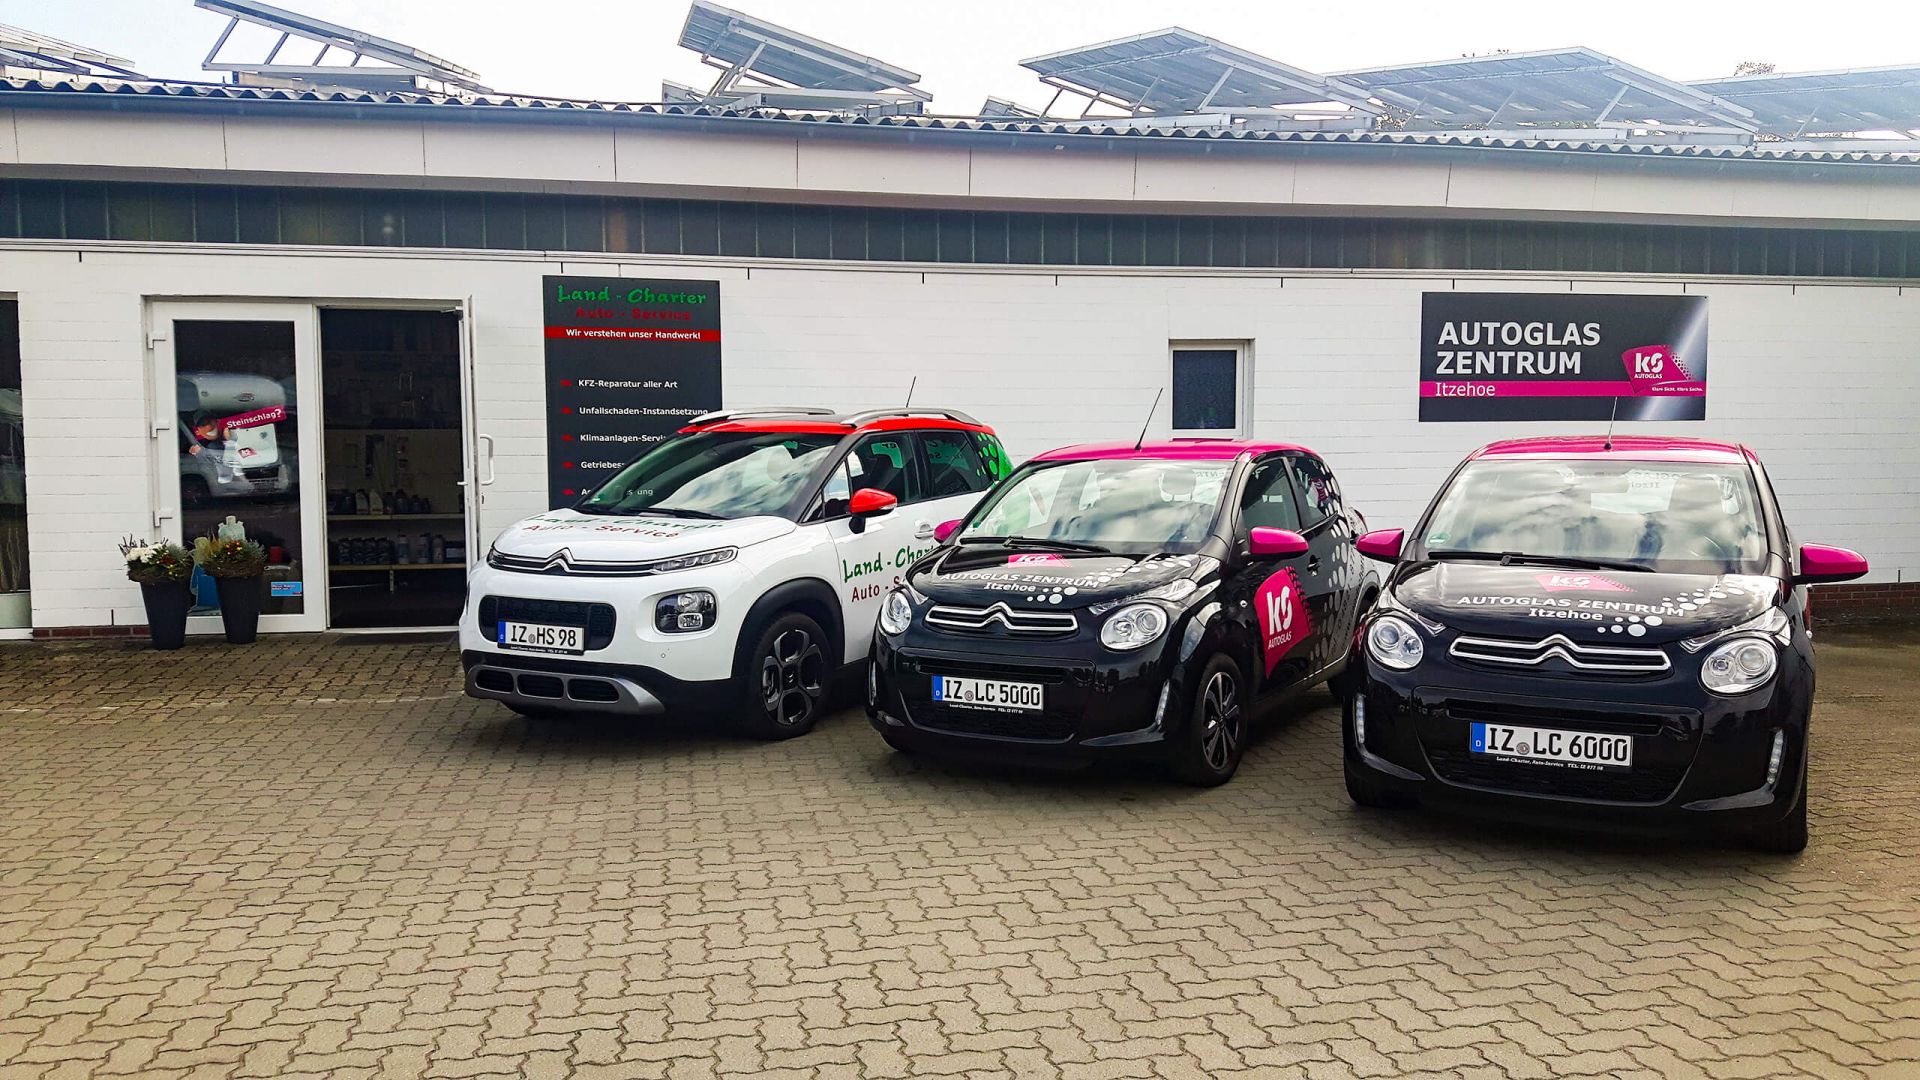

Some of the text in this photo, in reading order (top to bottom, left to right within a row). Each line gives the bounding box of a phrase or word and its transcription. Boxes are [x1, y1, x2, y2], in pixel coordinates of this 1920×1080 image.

[558, 285, 610, 302] Land
[627, 288, 706, 304] Charter
[576, 307, 614, 319] Auto
[631, 308, 692, 320] Service
[566, 329, 581, 337] Wir
[584, 329, 626, 338] verstehen
[655, 331, 701, 339] Handwerk!
[1437, 322, 1601, 346] AUTOGLAS
[1436, 351, 1581, 375] ZENTRUM
[578, 379, 678, 389] KFZ-Reparatur aller Art
[1435, 382, 1496, 397] Itzehoe
[226, 408, 282, 429] Steinschlag?
[580, 433, 666, 443] Klimaanlagen-Servi
[595, 525, 679, 538] Service
[843, 552, 884, 583] Land
[941, 573, 1100, 588] AUTOGLAS ZENTRUM
[983, 582, 1037, 592] Itzehoe
[852, 586, 880, 602] Auto
[1456, 596, 1684, 617] AUTOGLAS ZENTRUM
[1528, 607, 1603, 621] Itzehoe
[511, 625, 576, 647] IZ HS 98
[1267, 631, 1292, 650] AUTOGLAS
[944, 680, 962, 699] IZ
[975, 682, 995, 702] LC
[1000, 684, 1040, 706] 5000
[1487, 728, 1514, 752] IZ
[1534, 732, 1562, 756] LC
[1569, 735, 1627, 762] 6000
